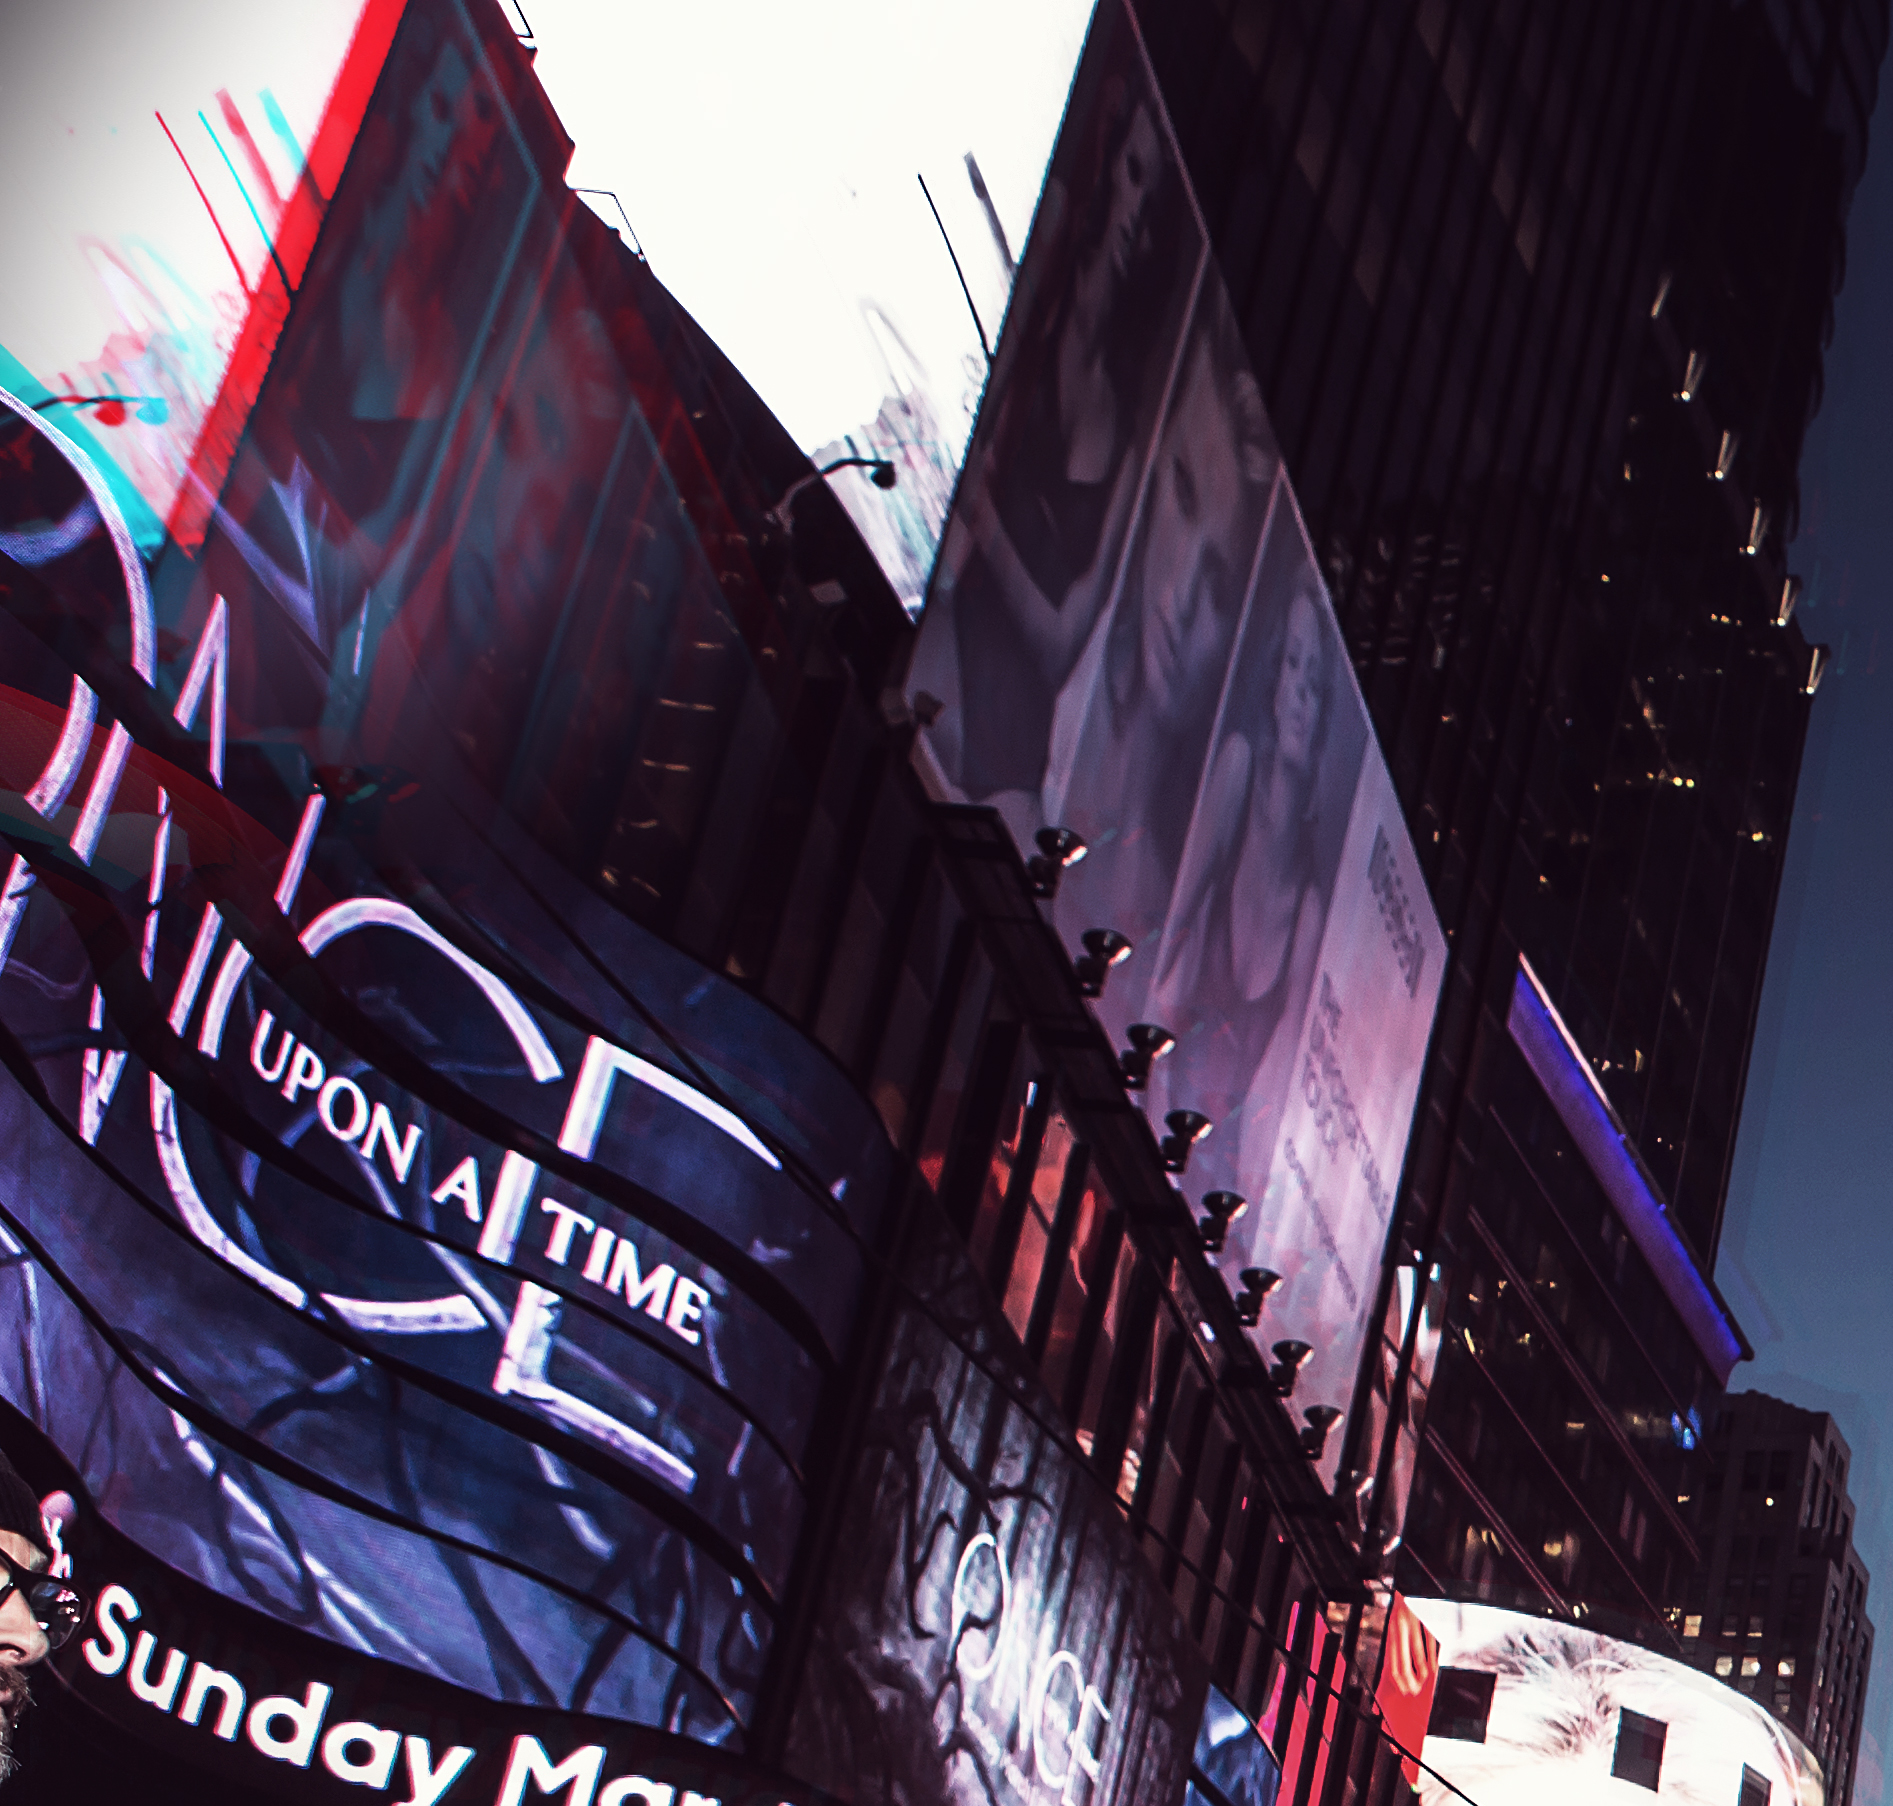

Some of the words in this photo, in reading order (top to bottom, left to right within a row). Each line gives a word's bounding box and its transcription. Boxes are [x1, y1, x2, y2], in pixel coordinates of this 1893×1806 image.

[250, 1010, 423, 1184] UPON
[432, 1157, 485, 1223] A
[540, 1198, 708, 1346] TIME
